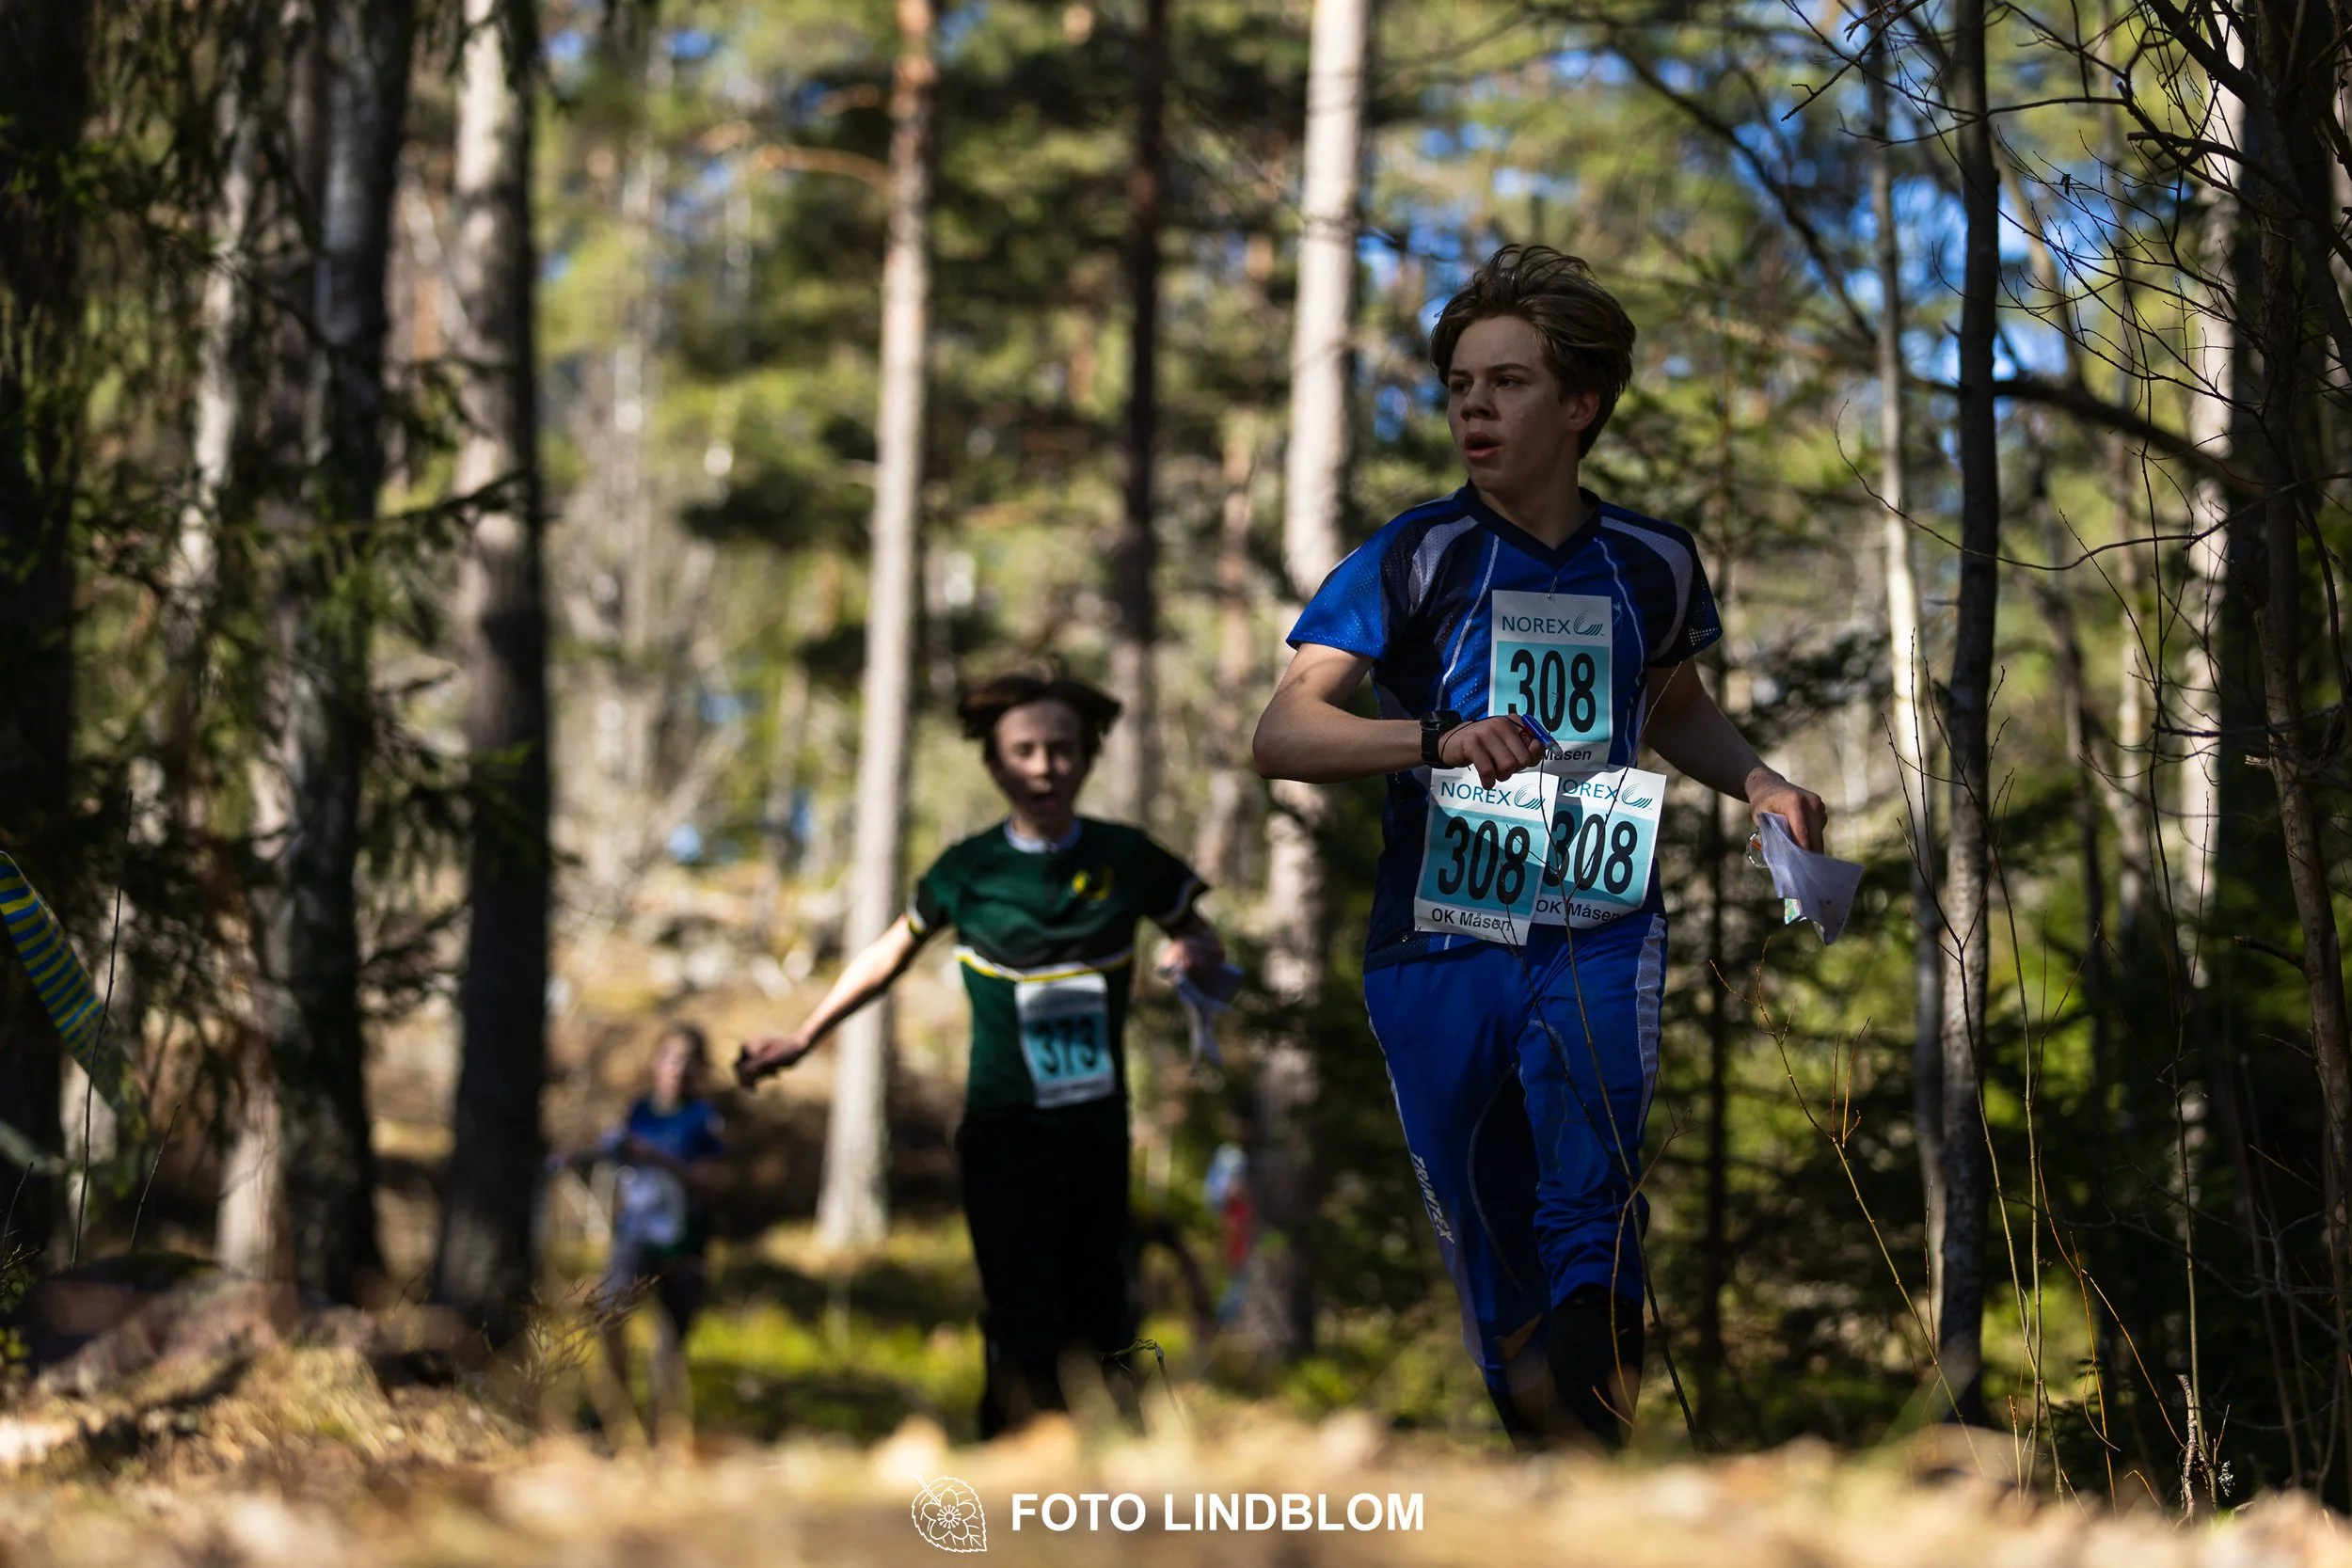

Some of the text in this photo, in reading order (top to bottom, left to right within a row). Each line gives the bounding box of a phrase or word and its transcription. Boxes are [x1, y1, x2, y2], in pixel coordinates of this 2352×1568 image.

[1502, 614, 1571, 636] NOREX
[1507, 649, 1597, 733] 308
[1441, 782, 1512, 806] NOREX
[1438, 816, 1531, 905] 308
[1543, 810, 1638, 895] 308
[1432, 908, 1511, 931] OK Måsen
[1535, 899, 1620, 922] OK Måsen
